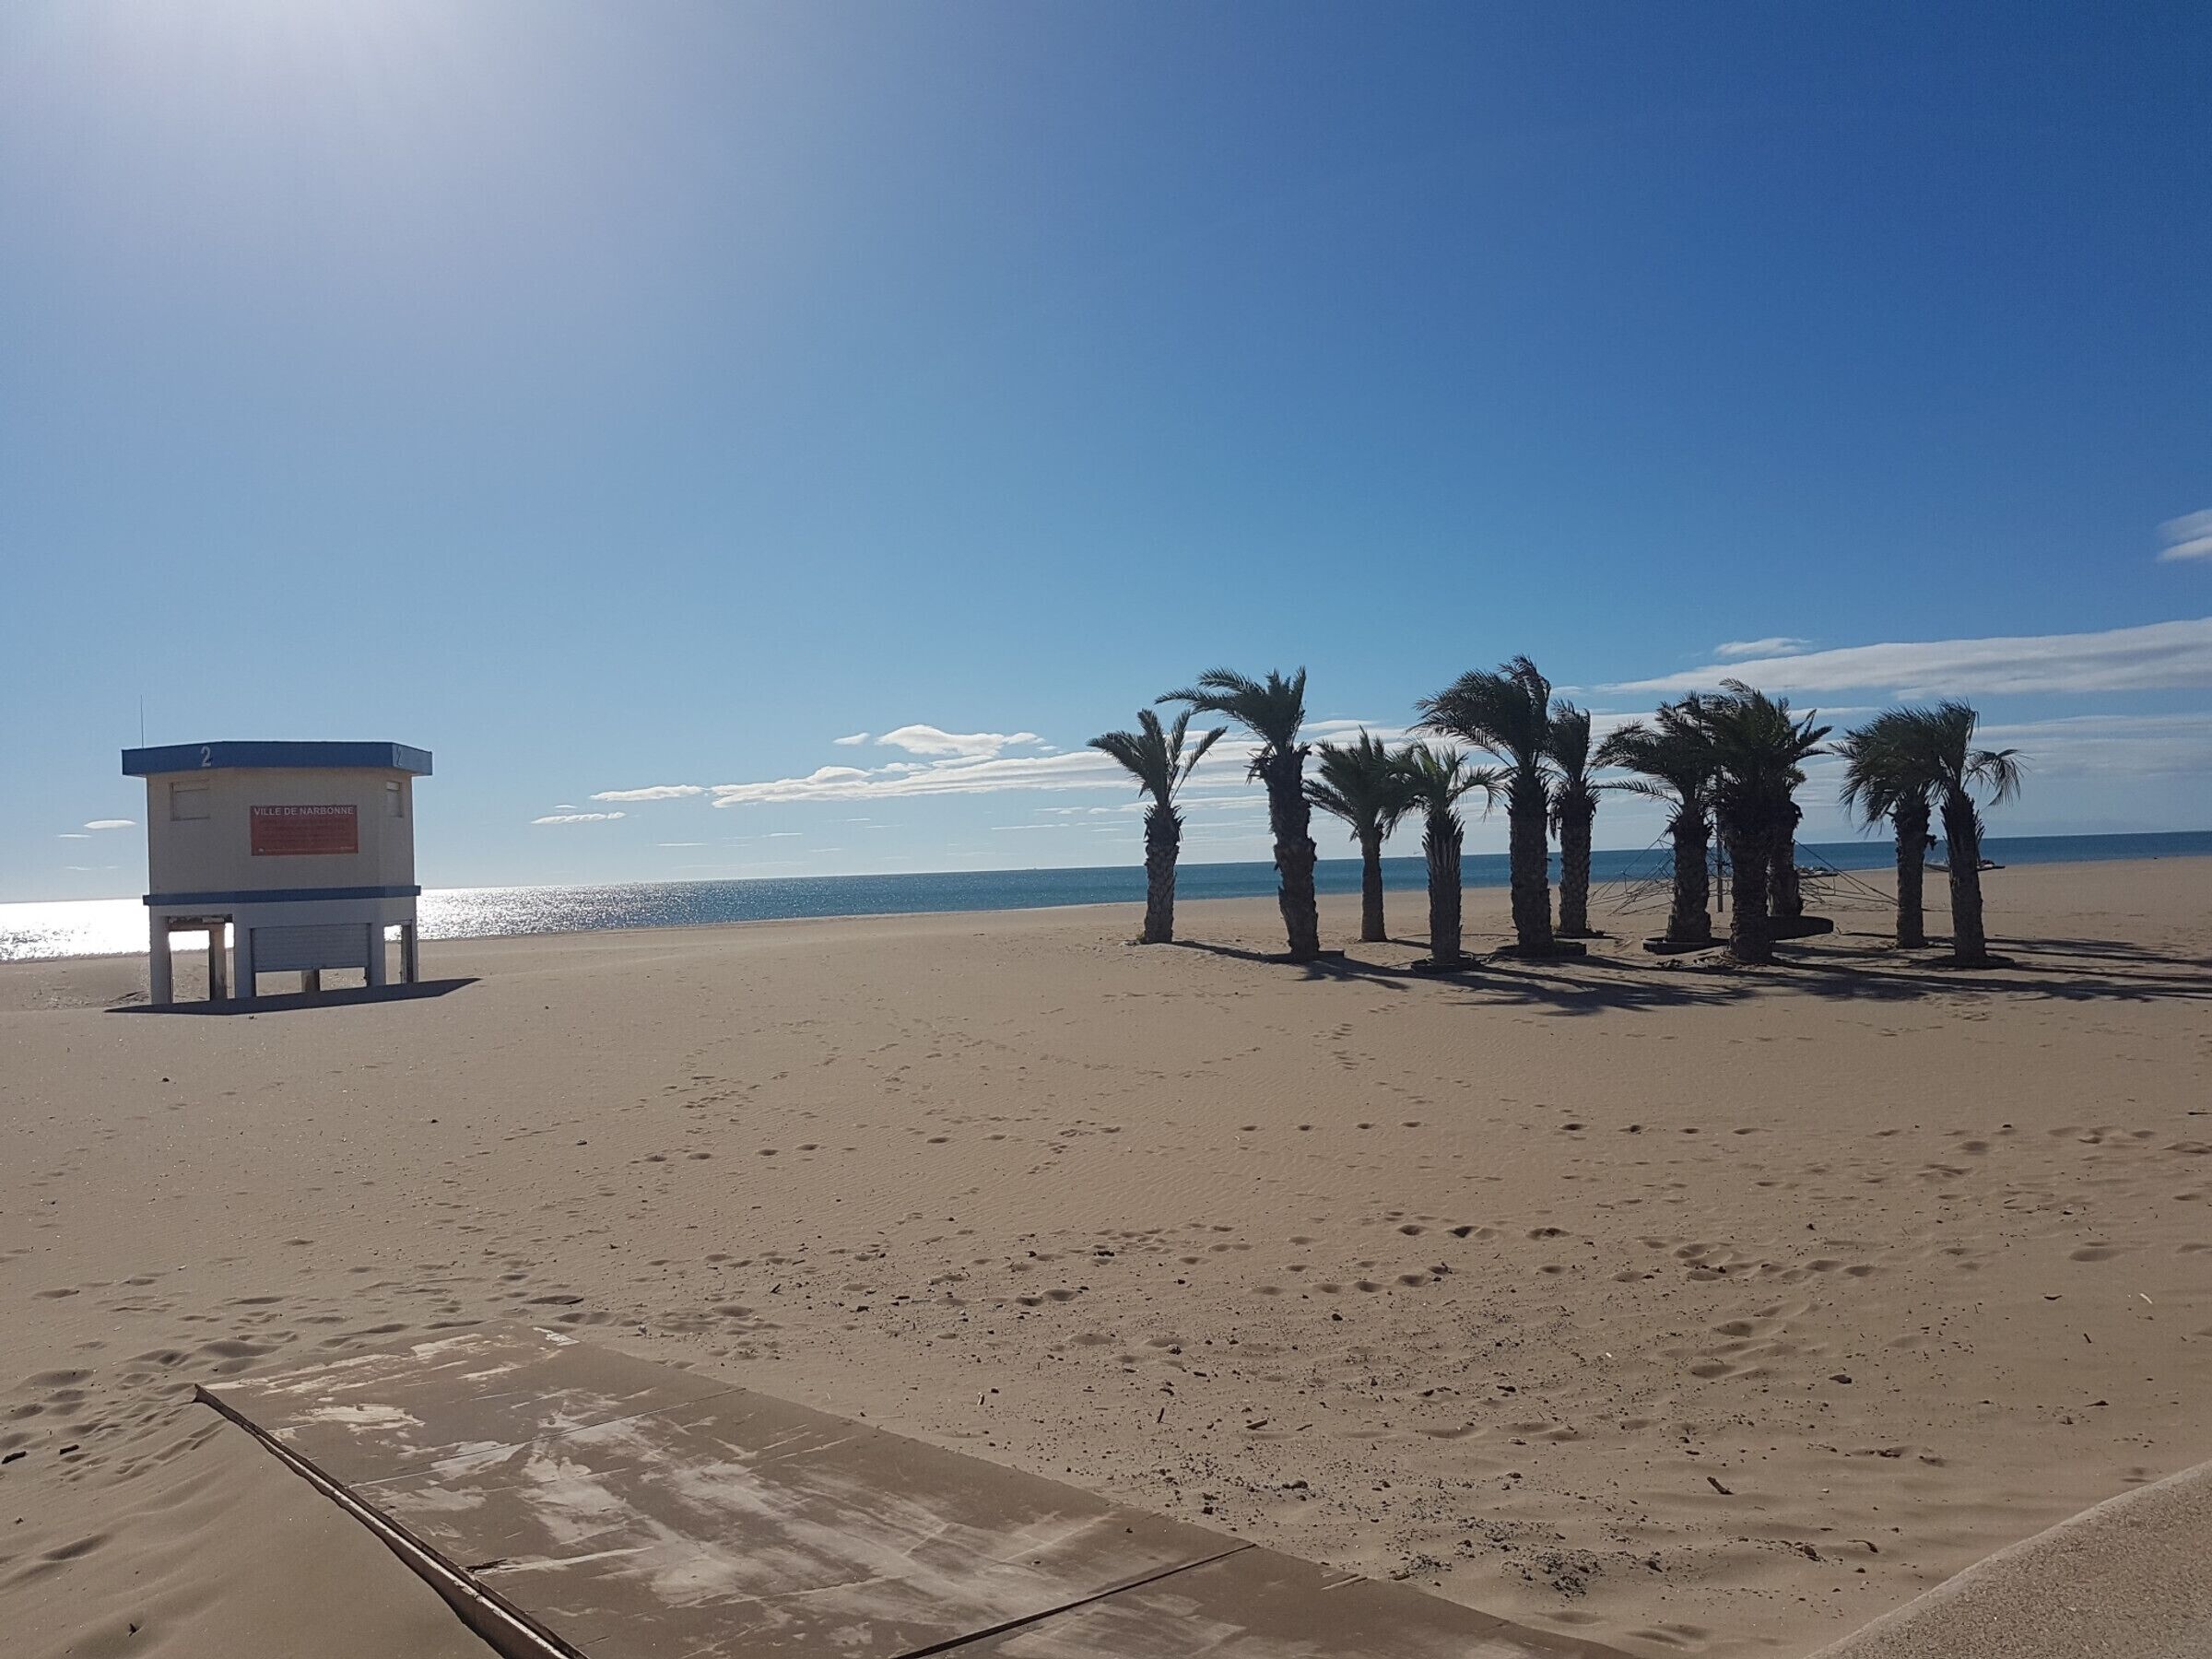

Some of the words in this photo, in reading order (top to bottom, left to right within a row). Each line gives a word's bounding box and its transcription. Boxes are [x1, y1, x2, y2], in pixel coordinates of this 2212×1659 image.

[200, 746, 211, 767] 2
[253, 807, 281, 816] VILLE
[284, 807, 299, 816] DE
[300, 806, 354, 815] NARBONNE
